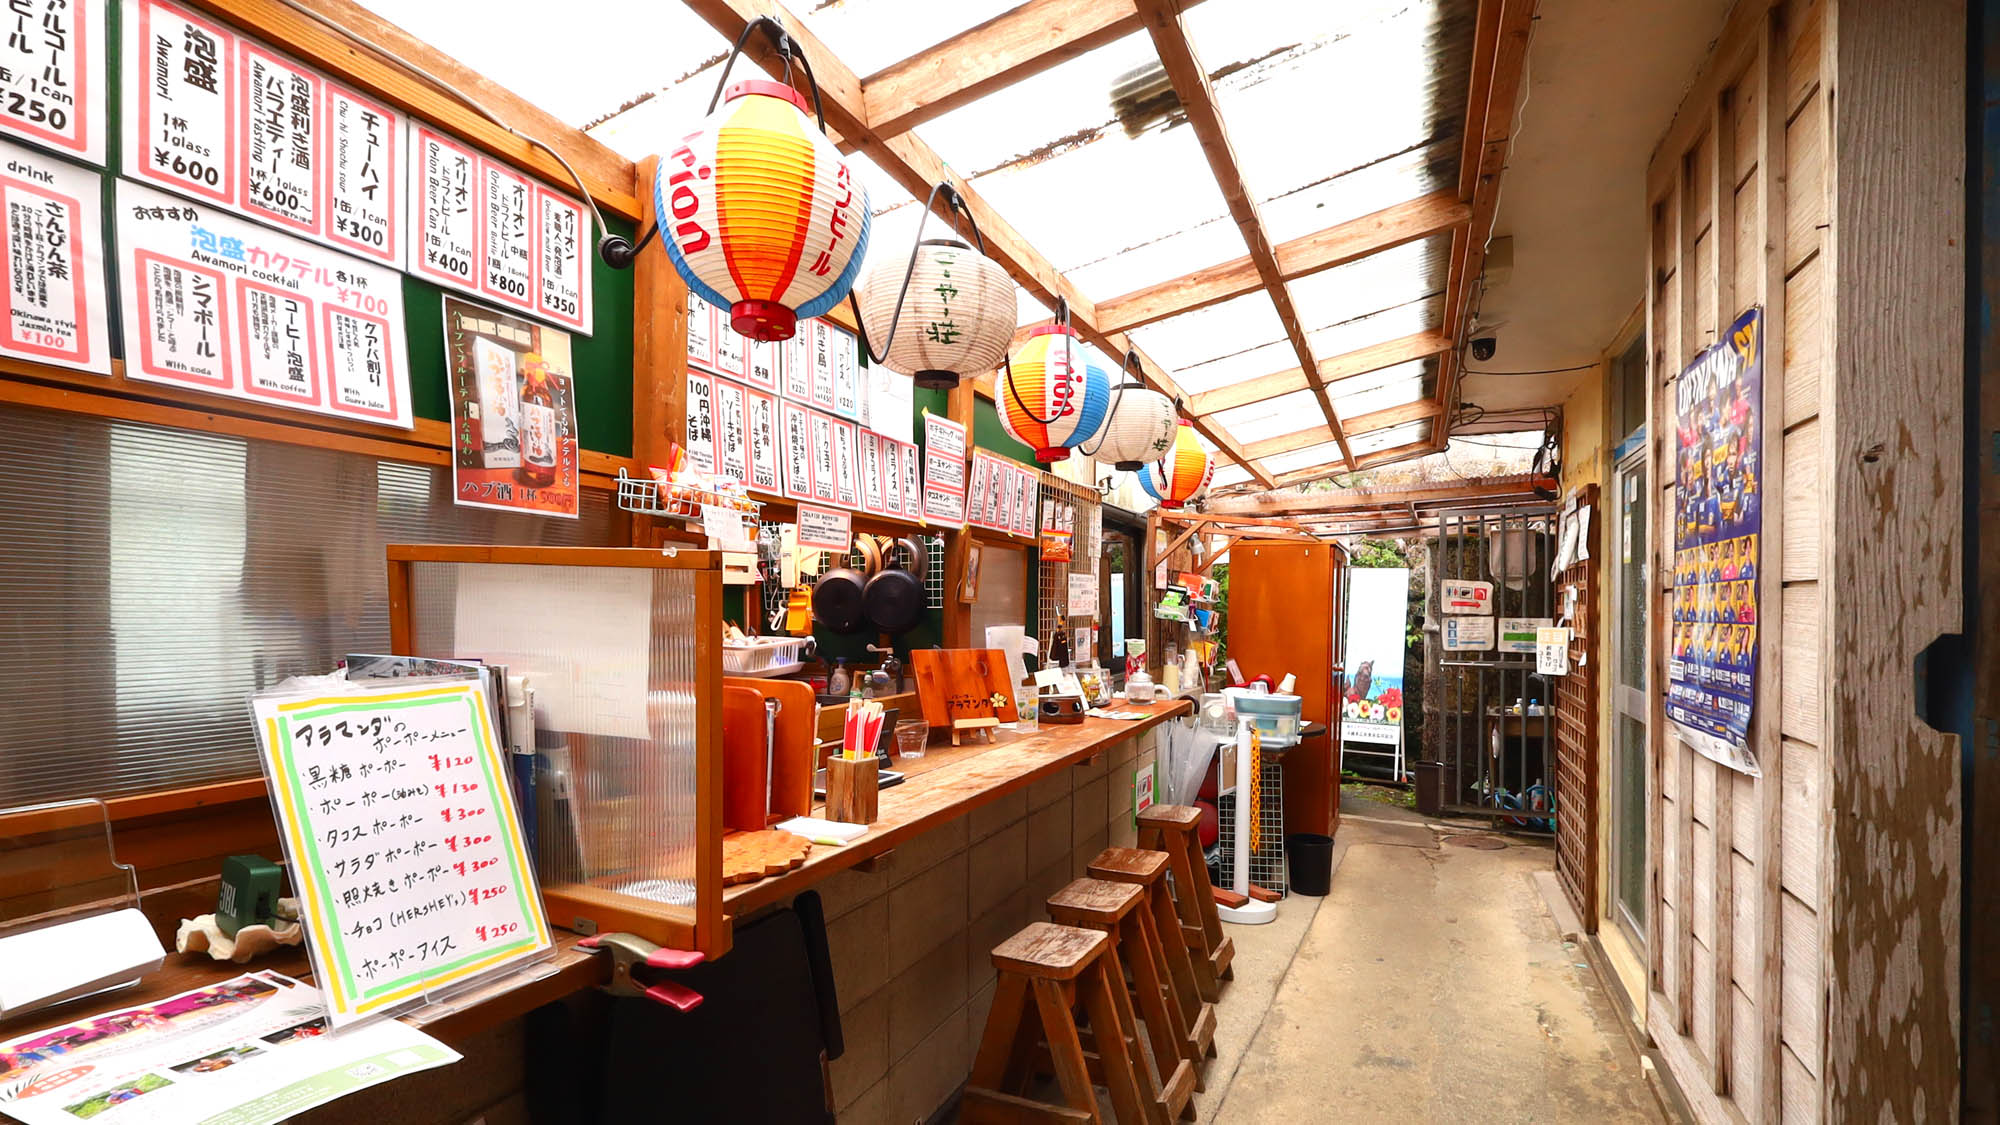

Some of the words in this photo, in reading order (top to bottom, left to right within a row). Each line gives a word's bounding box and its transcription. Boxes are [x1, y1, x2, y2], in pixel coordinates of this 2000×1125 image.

[155, 34, 173, 101] Awamori
[183, 24, 218, 95] 泡盛
[253, 60, 266, 116] Awamori
[162, 113, 188, 132] 1杯
[265, 75, 286, 174] バラエティー
[162, 130, 211, 158] 1glass
[252, 117, 266, 163] tasting
[155, 147, 219, 187] ¥600
[360, 110, 380, 201] チューハイ
[428, 141, 440, 174] Orion
[7, 160, 54, 185] drink
[340, 169, 349, 193] sour
[454, 156, 469, 214] オリオン
[489, 170, 500, 200] Orion
[428, 176, 440, 205] Beer
[133, 205, 199, 222] おすすめ
[429, 206, 440, 230] Can
[490, 202, 500, 229] Beer
[512, 184, 525, 238] オリオン
[45, 202, 68, 281] さんぴん茶
[336, 214, 383, 246] ¥300
[564, 209, 575, 260] オリオン
[191, 250, 247, 276] Awamori
[252, 267, 299, 290] cocktail
[428, 248, 469, 276] ¥400
[489, 270, 525, 297] ¥800
[192, 274, 216, 358] シマボール
[337, 287, 388, 317] ¥700
[544, 292, 576, 316] ¥350
[21, 329, 65, 349] ¥100
[285, 299, 305, 383] コーヒー泡盛
[165, 359, 188, 371] With
[688, 414, 699, 442] そば
[726, 399, 736, 453] ソーキそば
[752, 404, 762, 461] ソーキそば
[755, 474, 773, 486] ¥650
[427, 753, 473, 772] ¥120
[434, 783, 479, 798] ¥130
[440, 806, 487, 824] ¥300
[444, 834, 493, 853] ¥300
[452, 857, 500, 878] ¥300
[219, 880, 237, 918] JBL
[468, 884, 508, 907] ¥250
[475, 921, 518, 943] ¥250
